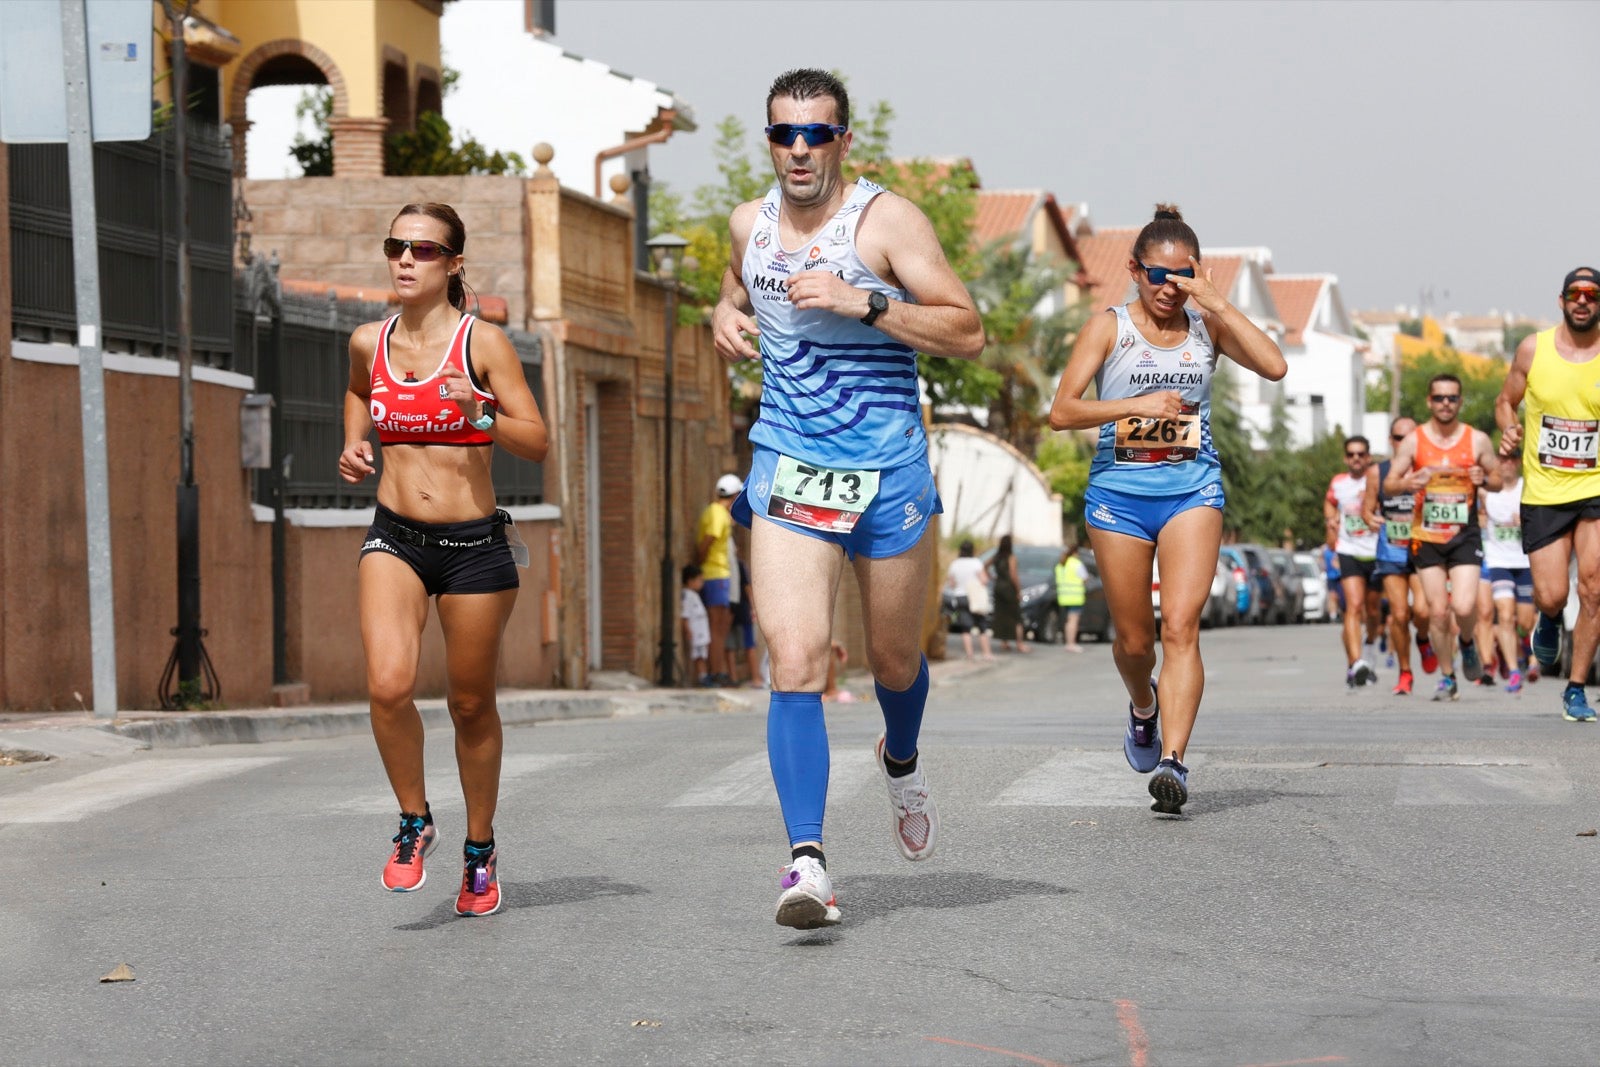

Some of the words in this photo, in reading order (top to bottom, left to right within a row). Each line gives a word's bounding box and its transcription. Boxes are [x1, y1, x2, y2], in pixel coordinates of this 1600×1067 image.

[1129, 373, 1203, 385] MARACENA
[389, 411, 429, 423] Clínicas
[1127, 417, 1194, 443] 2267
[1547, 432, 1594, 452] 3017
[794, 464, 861, 504] 713
[1431, 505, 1458, 519] 561
